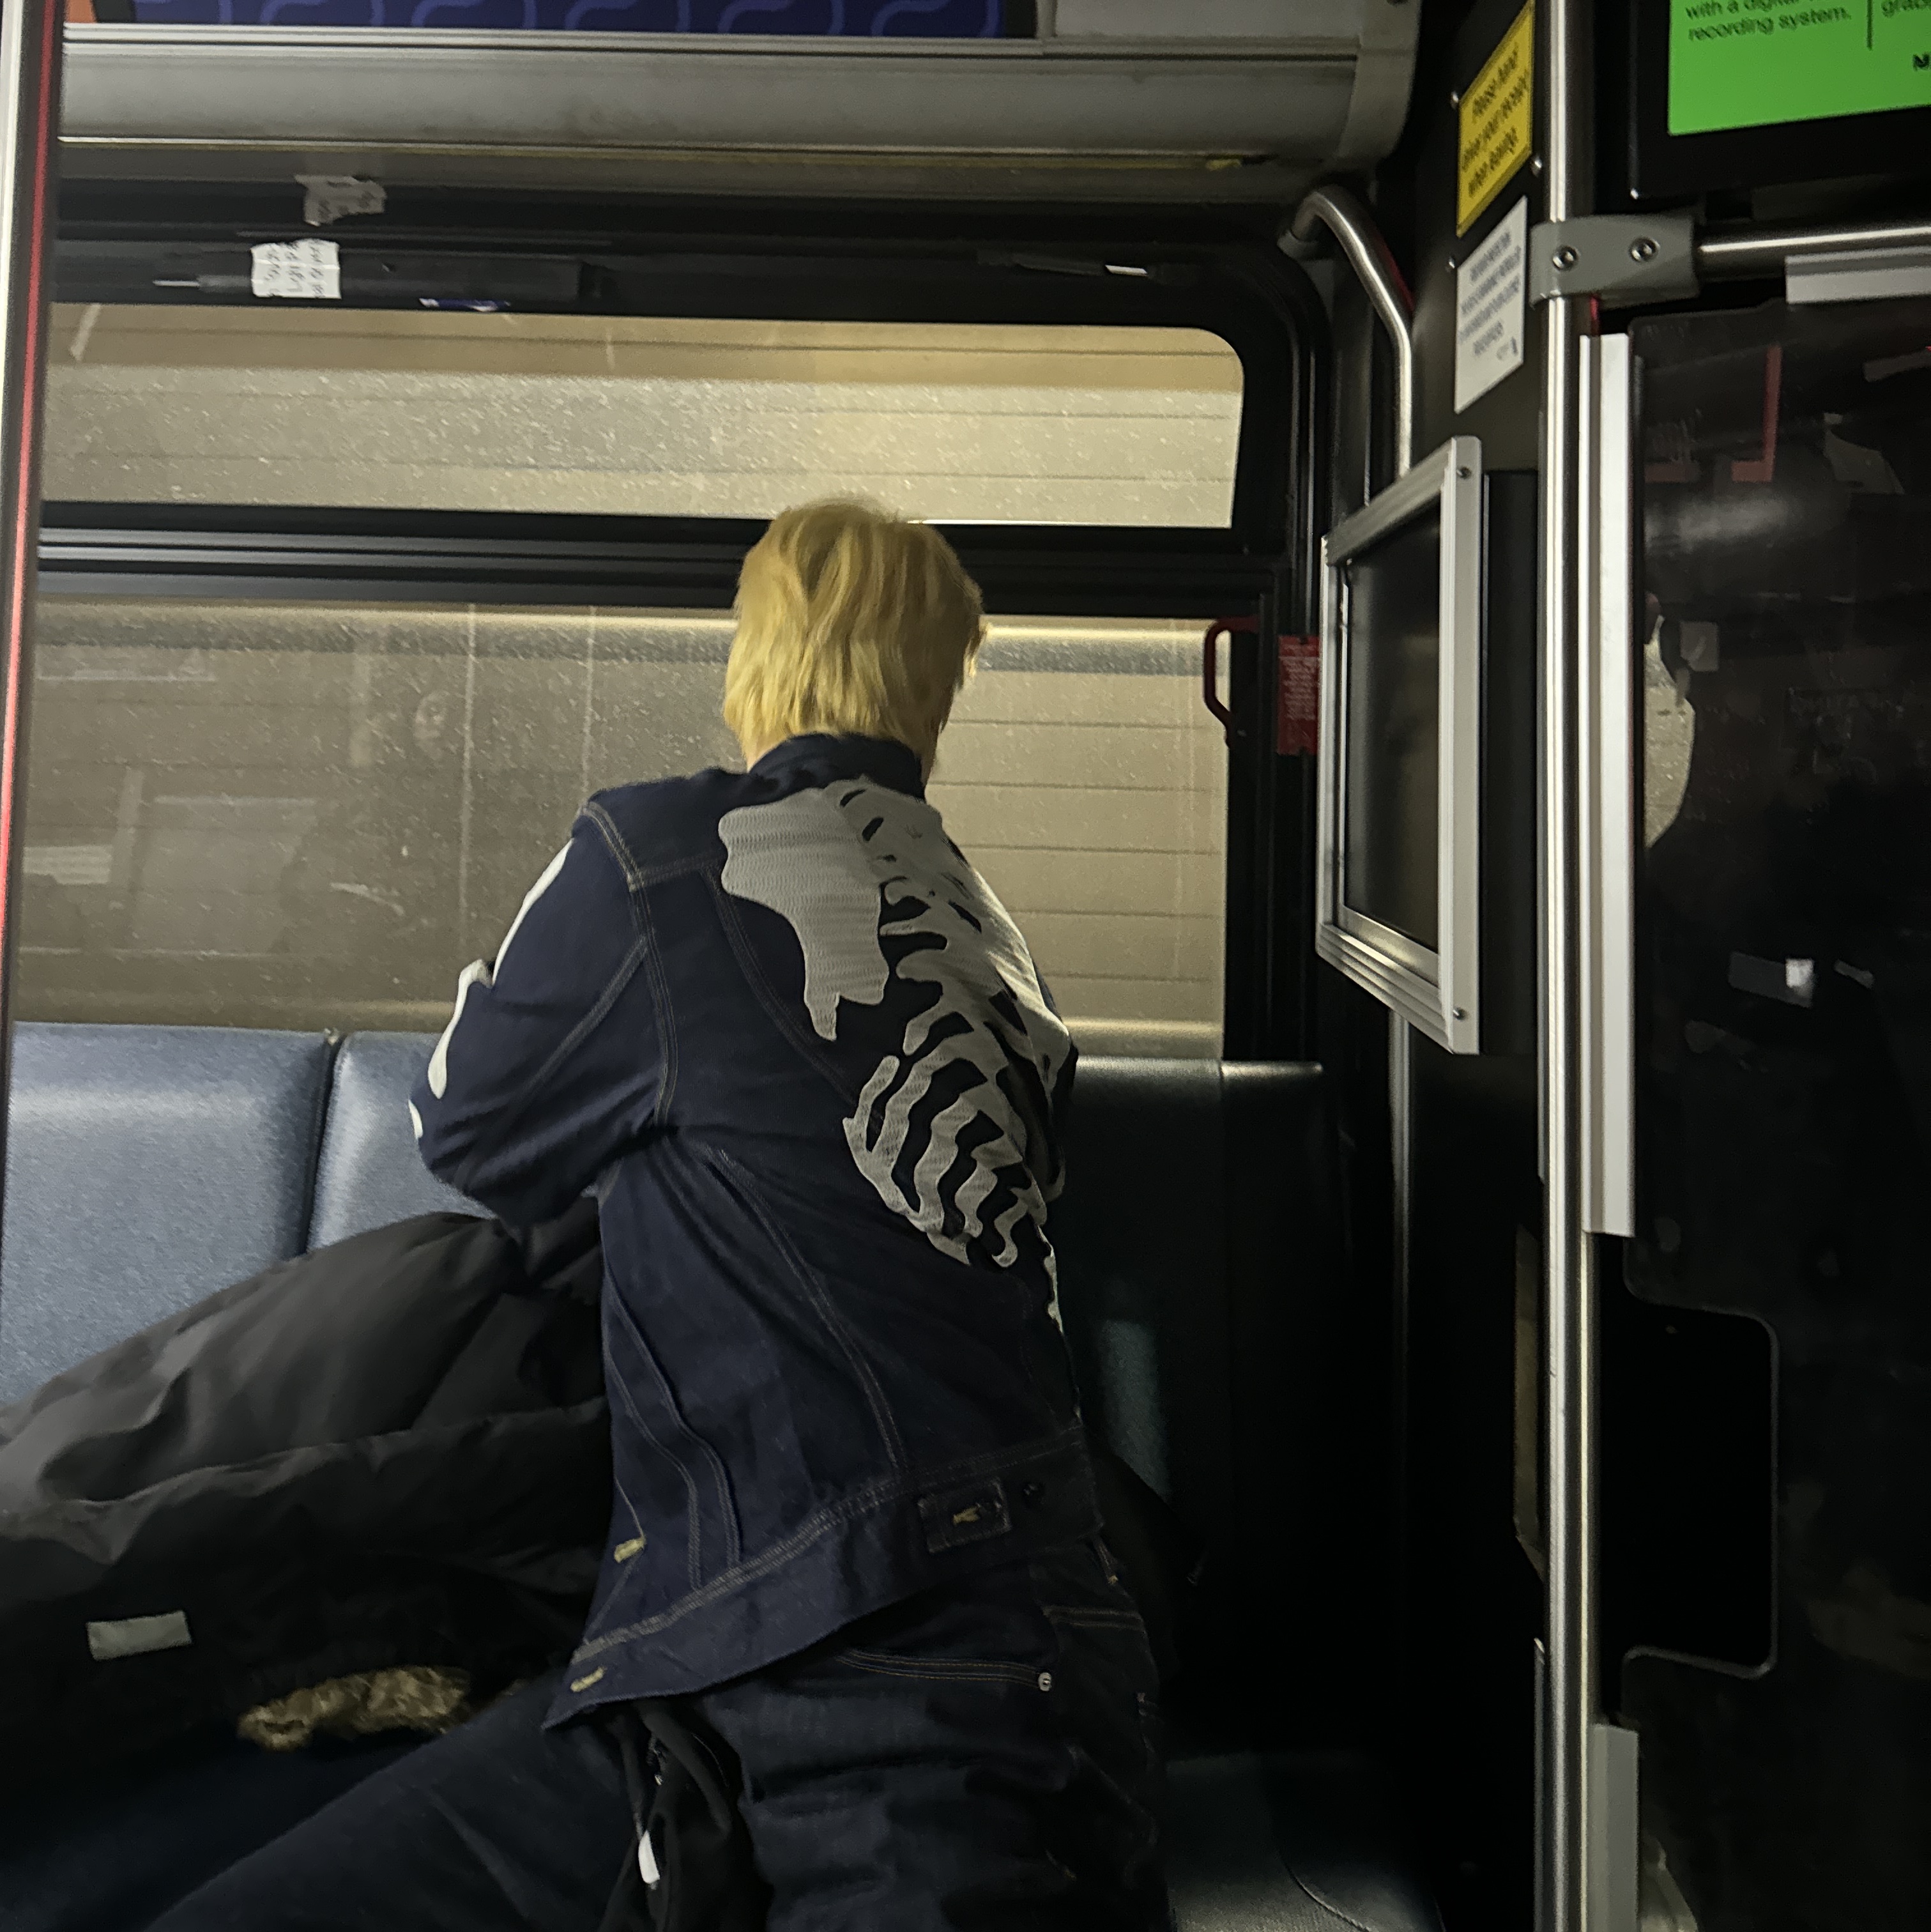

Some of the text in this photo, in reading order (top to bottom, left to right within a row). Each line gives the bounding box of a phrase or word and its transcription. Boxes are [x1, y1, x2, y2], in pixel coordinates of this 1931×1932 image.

[1685, 1, 1721, 19] with
[1727, 0, 1739, 13] a
[1688, 7, 1851, 41] recording system.
